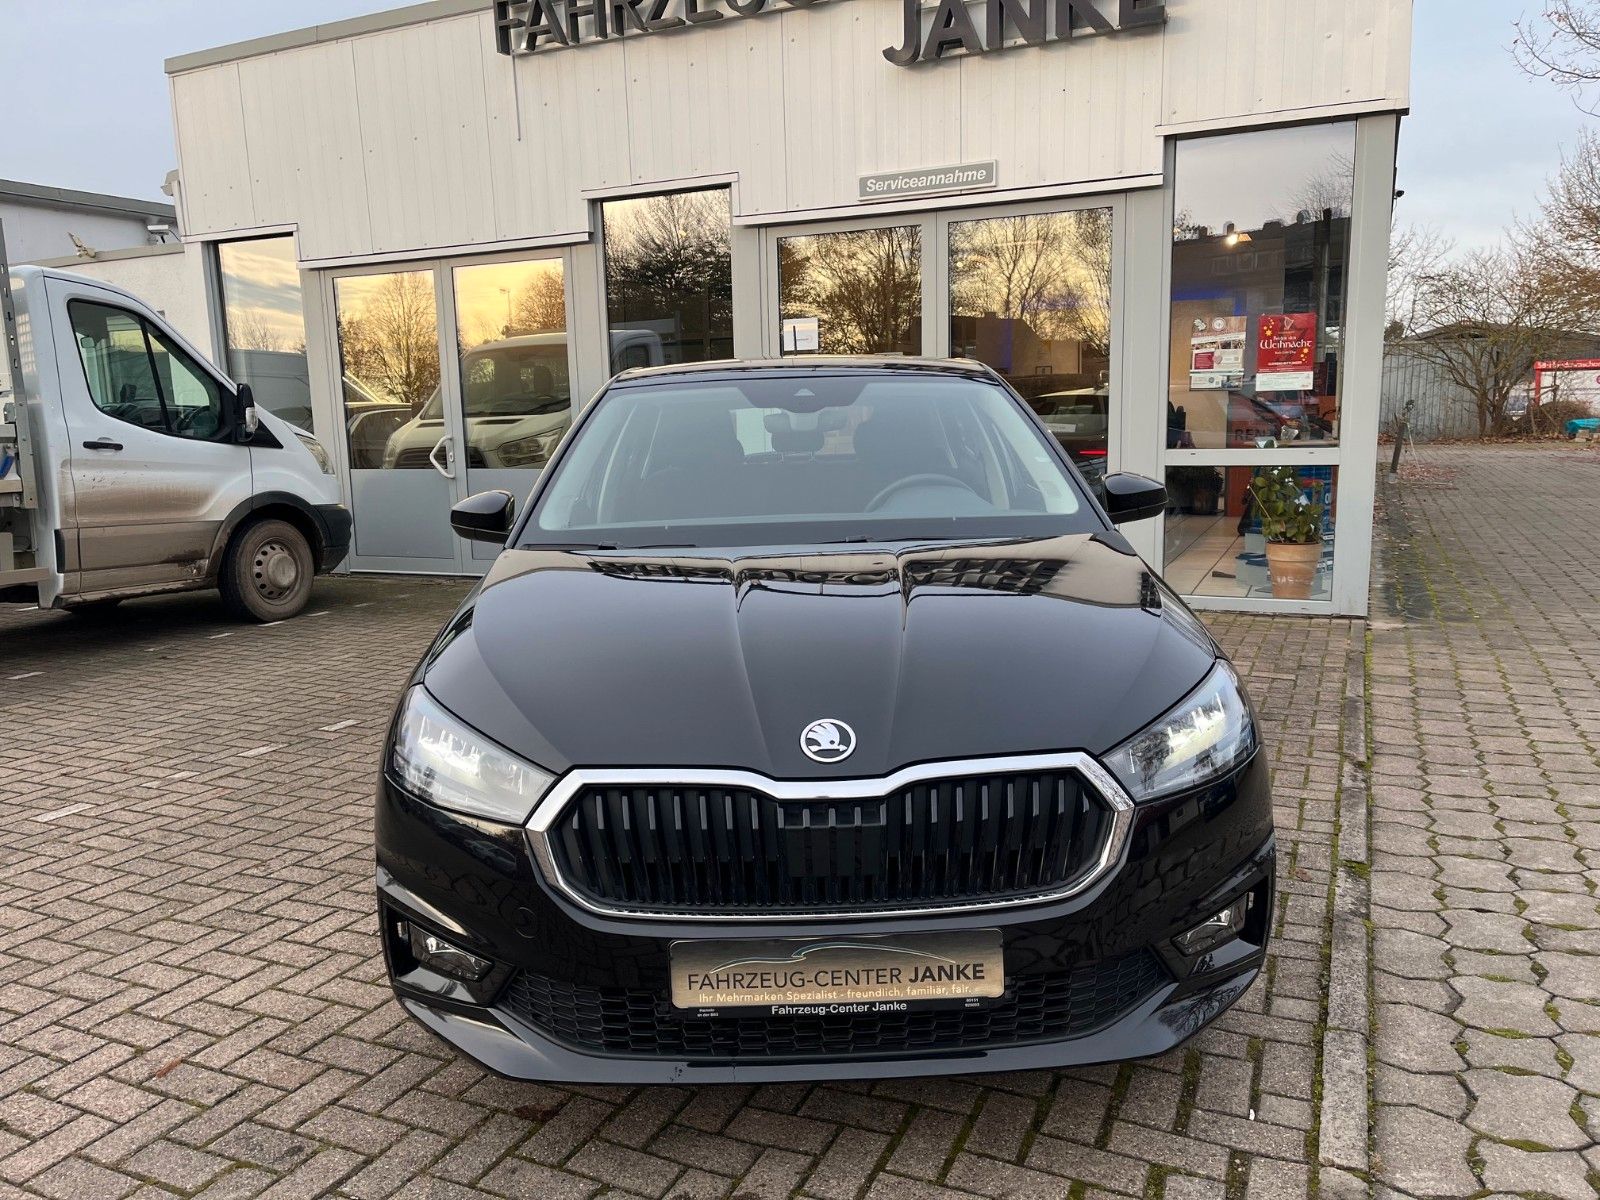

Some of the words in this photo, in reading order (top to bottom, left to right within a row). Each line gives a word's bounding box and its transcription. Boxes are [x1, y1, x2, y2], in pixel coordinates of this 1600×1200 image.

[493, 0, 813, 55] FAHRZ
[866, 169, 987, 192] Serviceannahme
[1260, 339, 1313, 350] Weihnacht
[688, 968, 902, 990] FAHRZEUG-CENTER
[909, 964, 985, 982] JANKE
[698, 993, 713, 1003] Ihr
[716, 991, 784, 1003] Mehrmarken
[786, 990, 837, 1002] Spezialist
[847, 987, 904, 999] freundlich,
[906, 985, 949, 998] familiär,
[951, 983, 972, 994] fair.
[771, 1003, 870, 1015] Fahrzeug-Center
[872, 1001, 908, 1012] Janke
